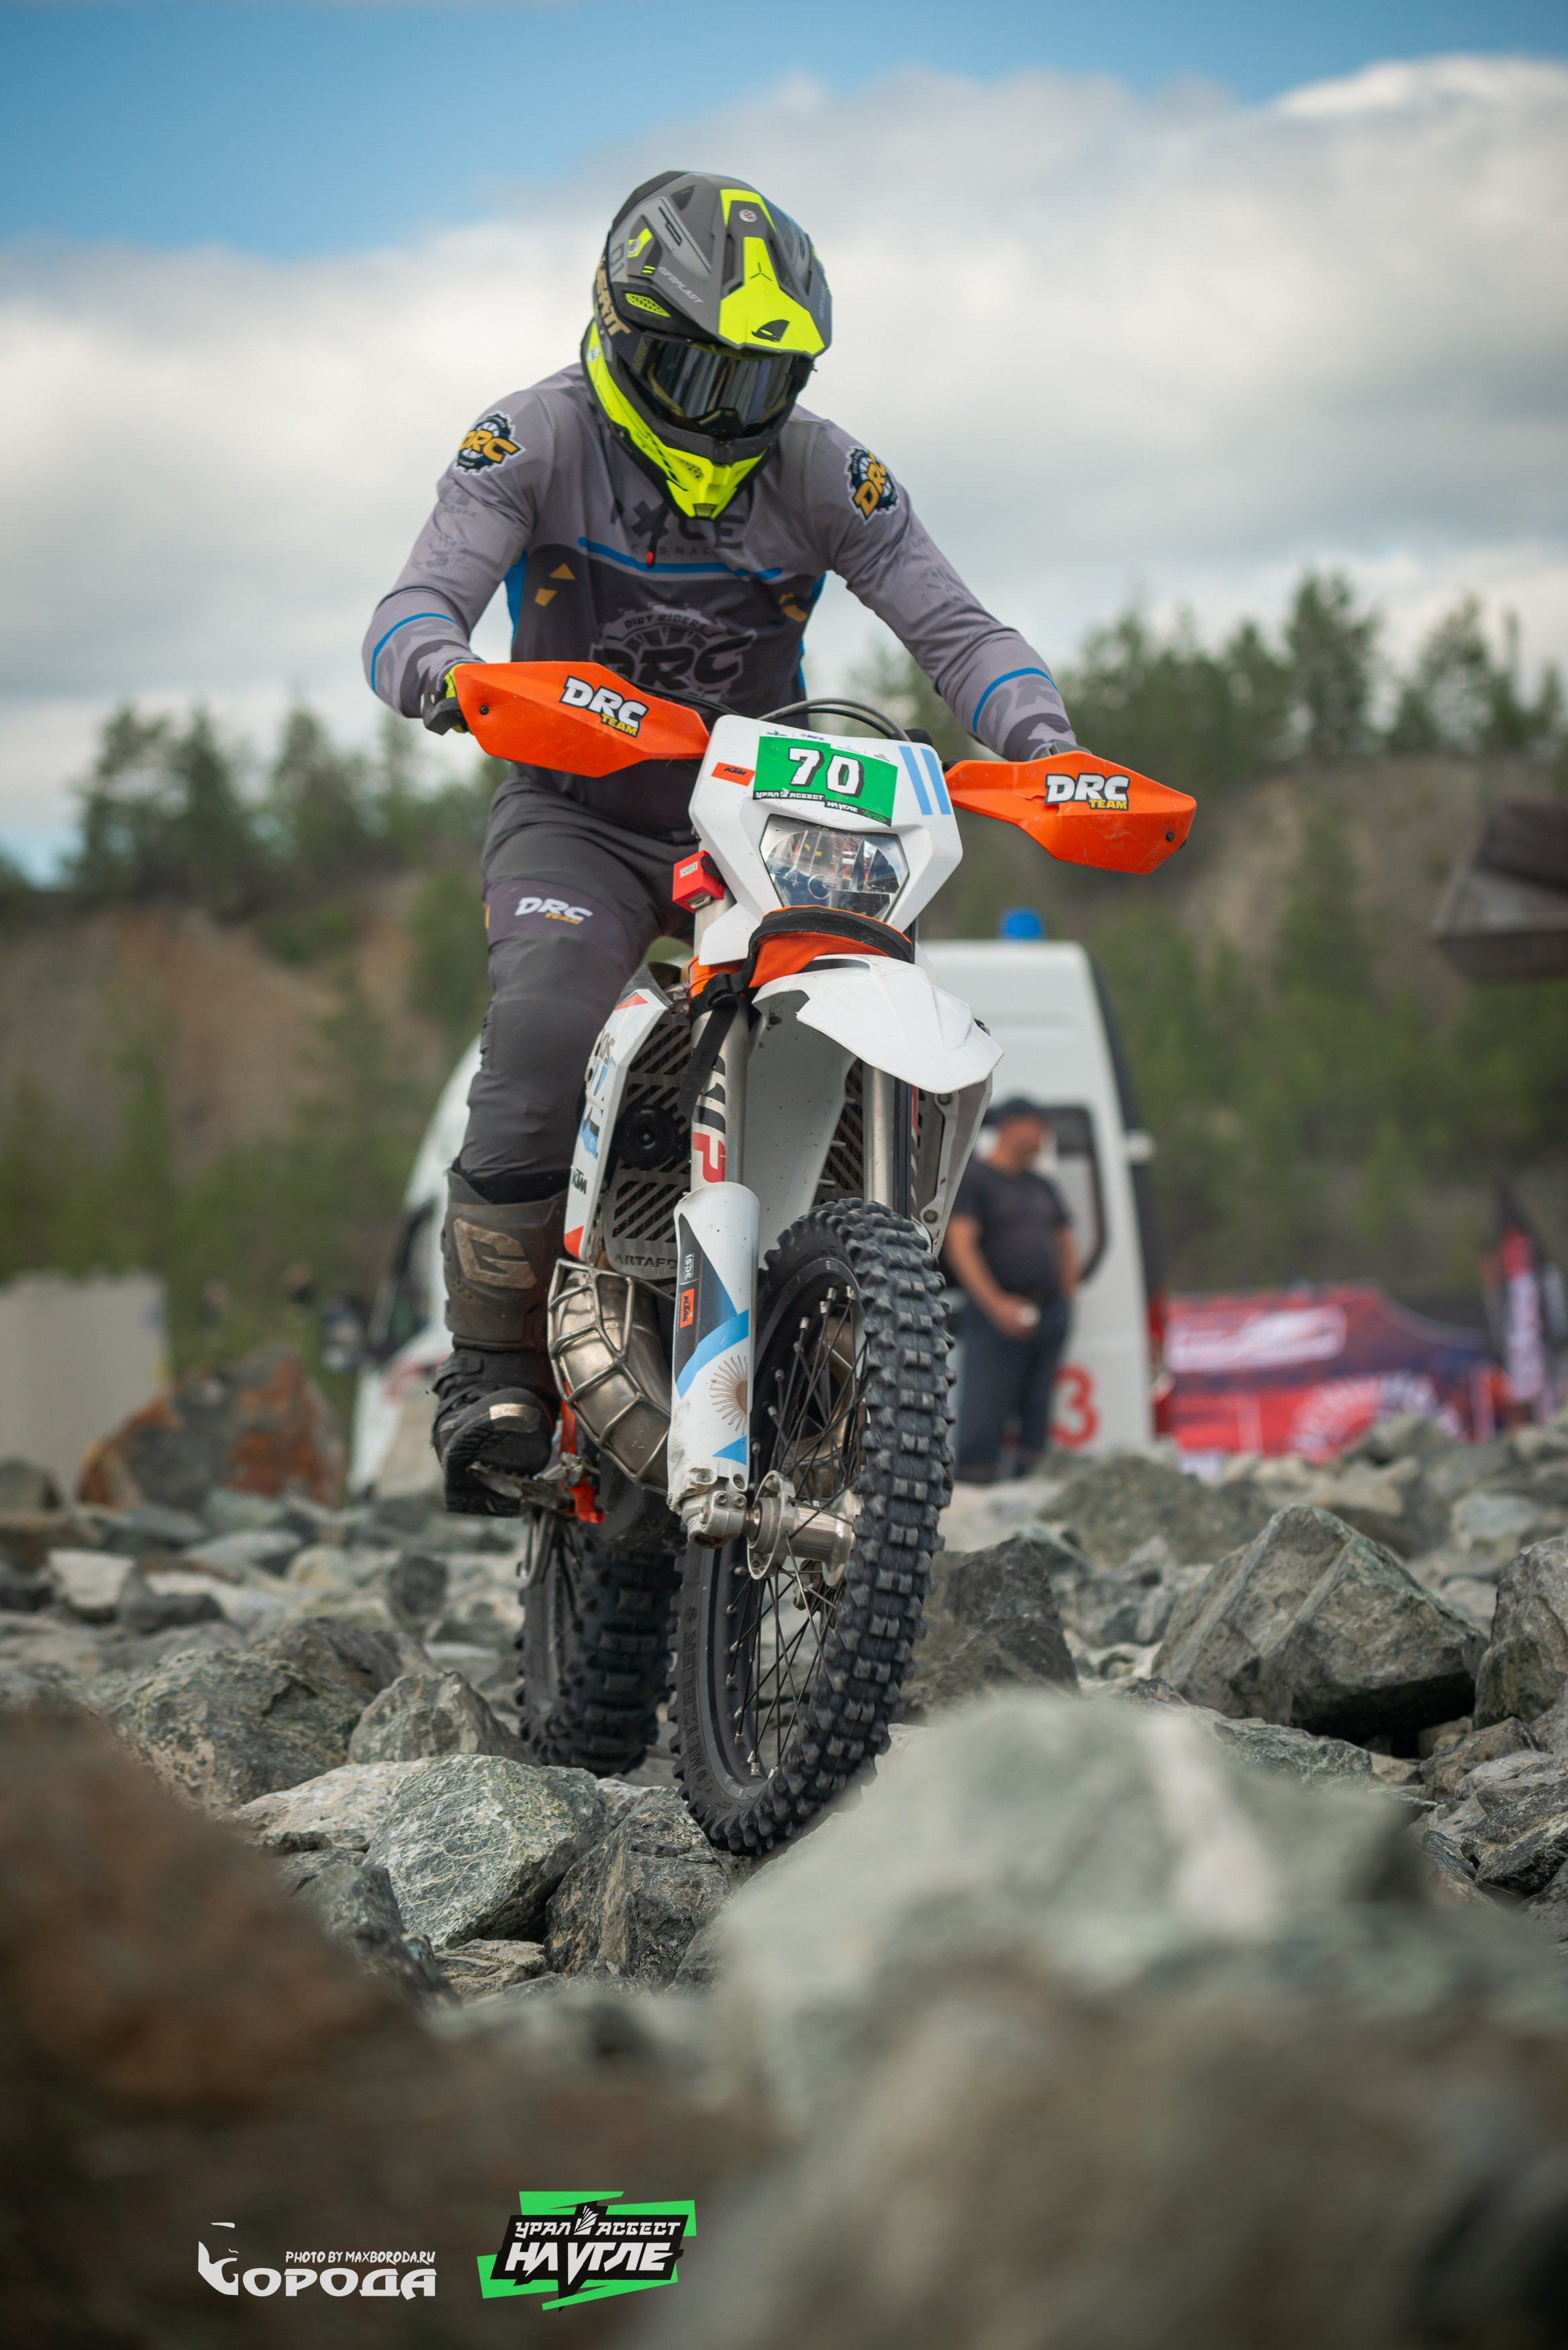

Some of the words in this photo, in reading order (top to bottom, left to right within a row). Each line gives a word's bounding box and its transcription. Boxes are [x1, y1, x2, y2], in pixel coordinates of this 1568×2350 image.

[624, 614, 653, 629] DIRT
[658, 614, 709, 630] RIDERS
[560, 677, 649, 728] DRC
[601, 713, 639, 737] TEAM
[789, 747, 864, 798] 70
[1046, 774, 1130, 803] DRC
[1089, 799, 1128, 810] TEAM
[514, 897, 593, 922] DRC
[571, 1168, 587, 1195] KTM
